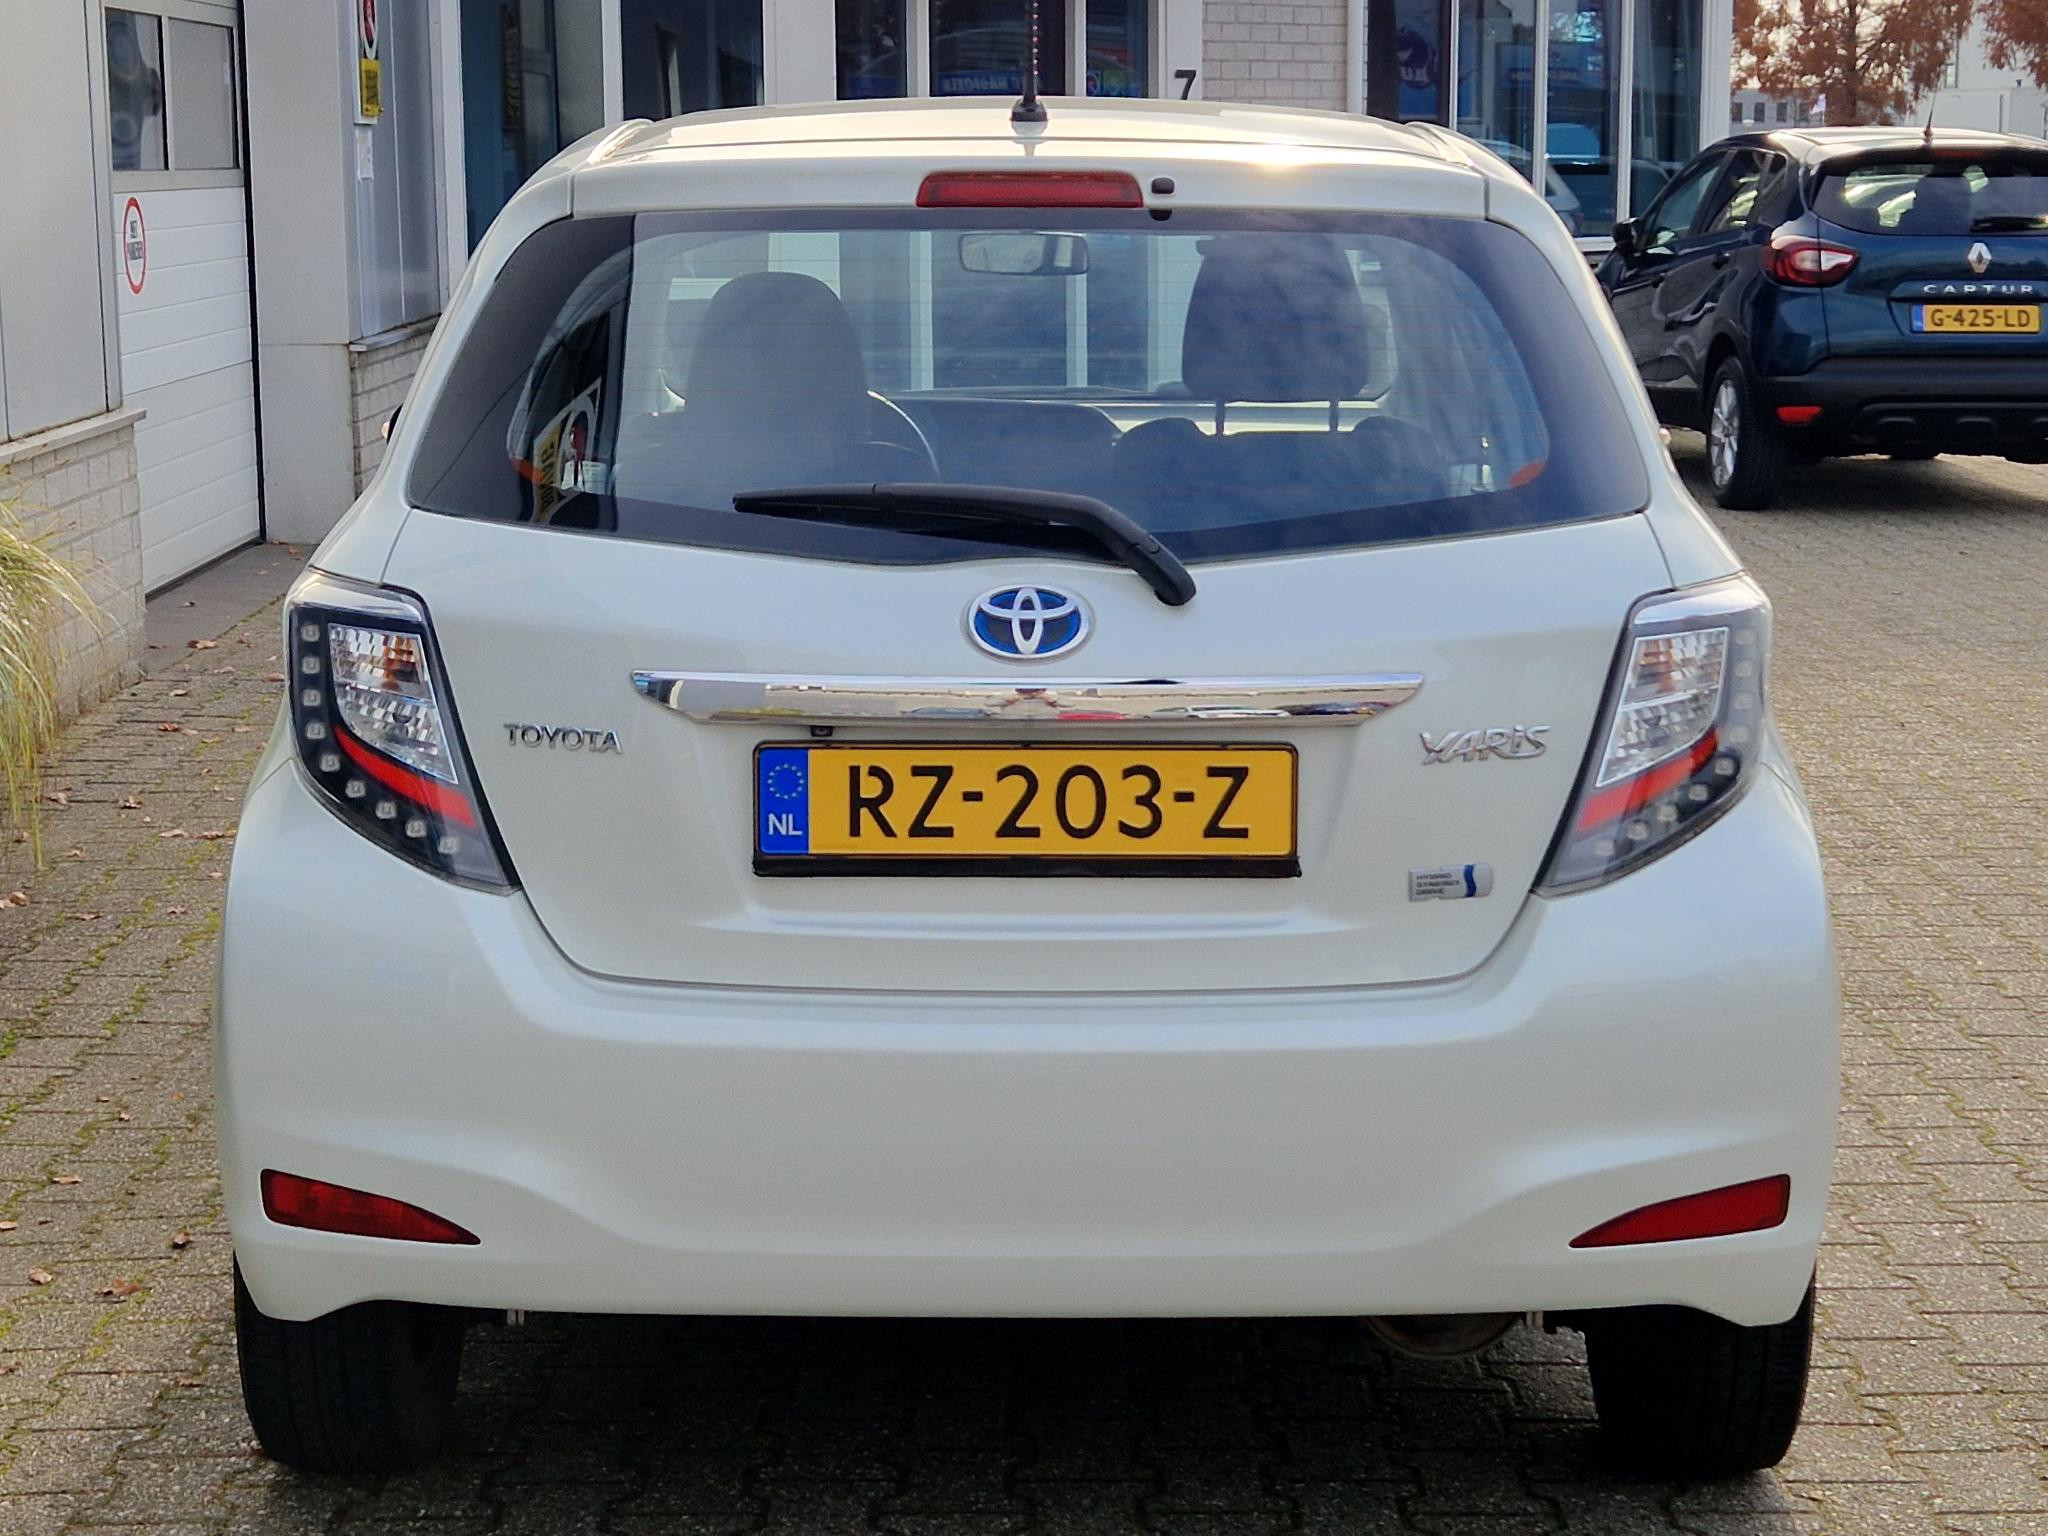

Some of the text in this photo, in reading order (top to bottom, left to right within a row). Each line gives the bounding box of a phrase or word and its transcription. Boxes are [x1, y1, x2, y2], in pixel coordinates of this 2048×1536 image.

[1174, 69, 1197, 100] 7
[1923, 284, 2033, 294] CAPTUR
[1931, 309, 2031, 328] G-425-LD
[503, 723, 623, 755] TOYOTA
[847, 764, 1251, 840] RZ-203-Z
[768, 813, 802, 835] NL
